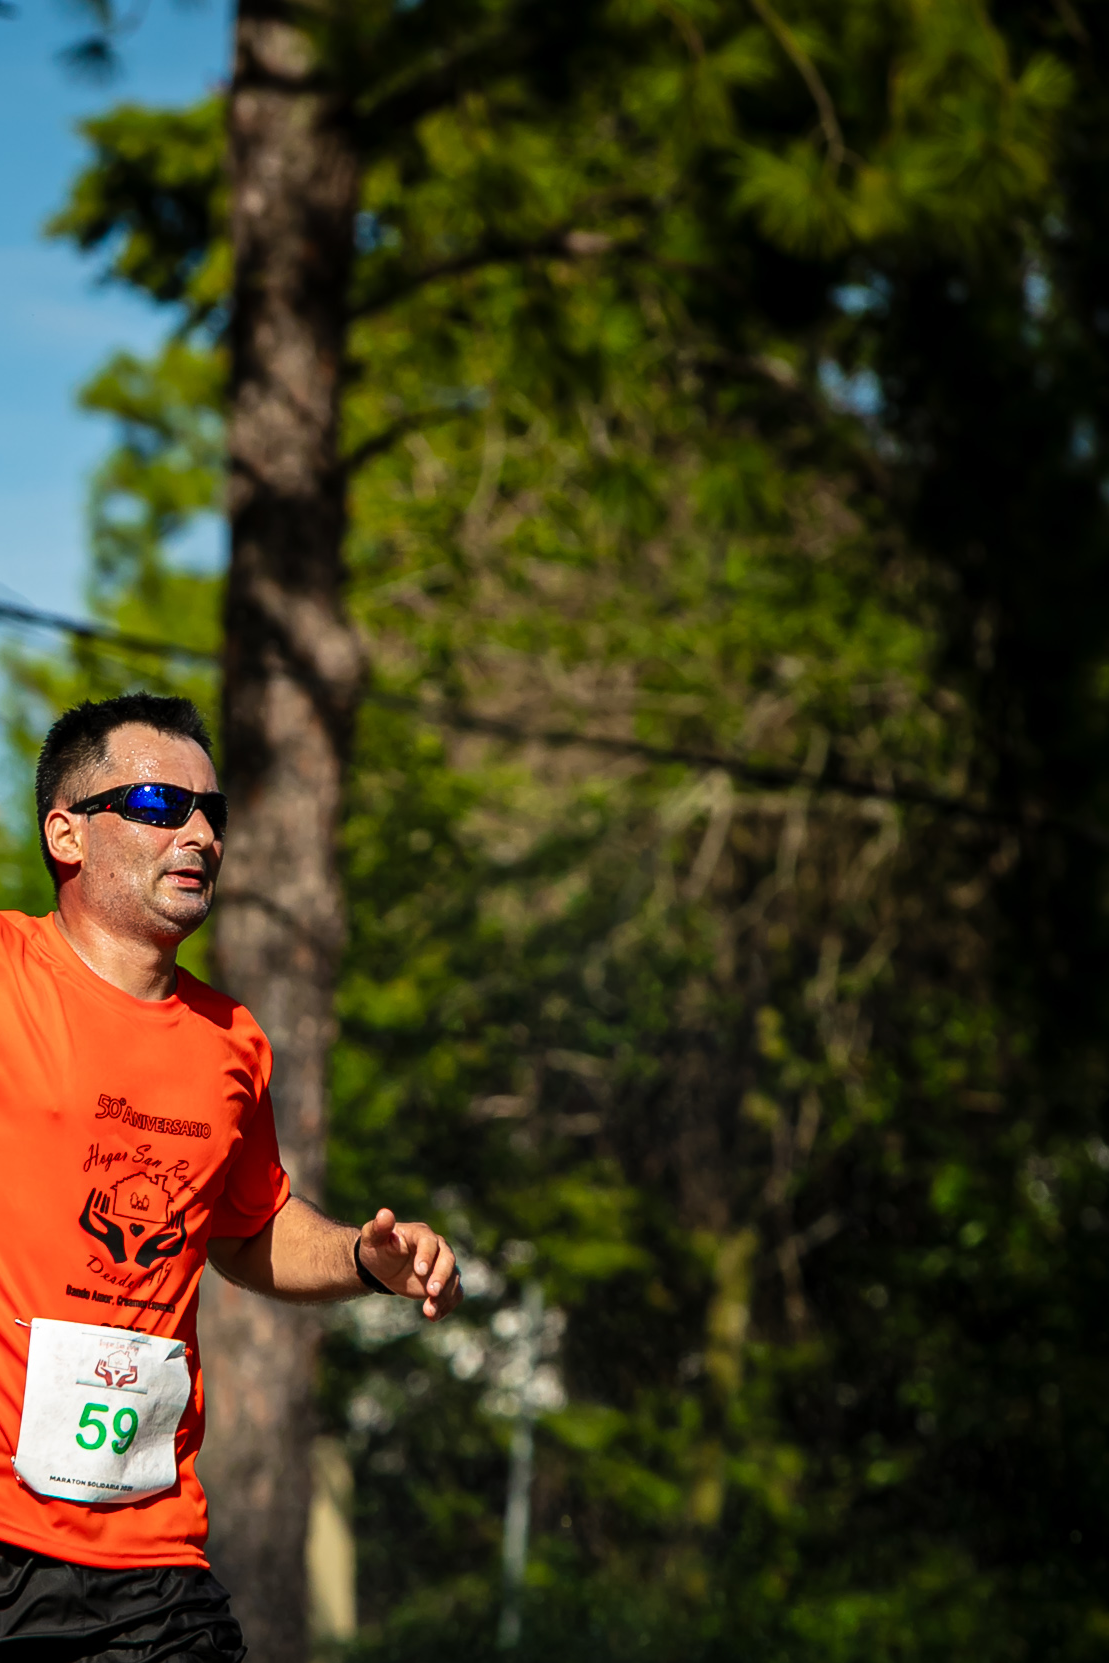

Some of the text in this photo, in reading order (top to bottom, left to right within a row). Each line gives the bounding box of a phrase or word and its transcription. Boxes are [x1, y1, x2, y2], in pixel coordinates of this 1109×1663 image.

[122, 1106, 212, 1139] ANIVERSARIO
[83, 1142, 128, 1173] Hogar
[132, 1144, 163, 1168] San
[86, 1254, 135, 1289] Desde
[75, 1402, 139, 1455] 59
[49, 1475, 86, 1486] MARATON
[87, 1480, 119, 1490] SOLIDARIA
